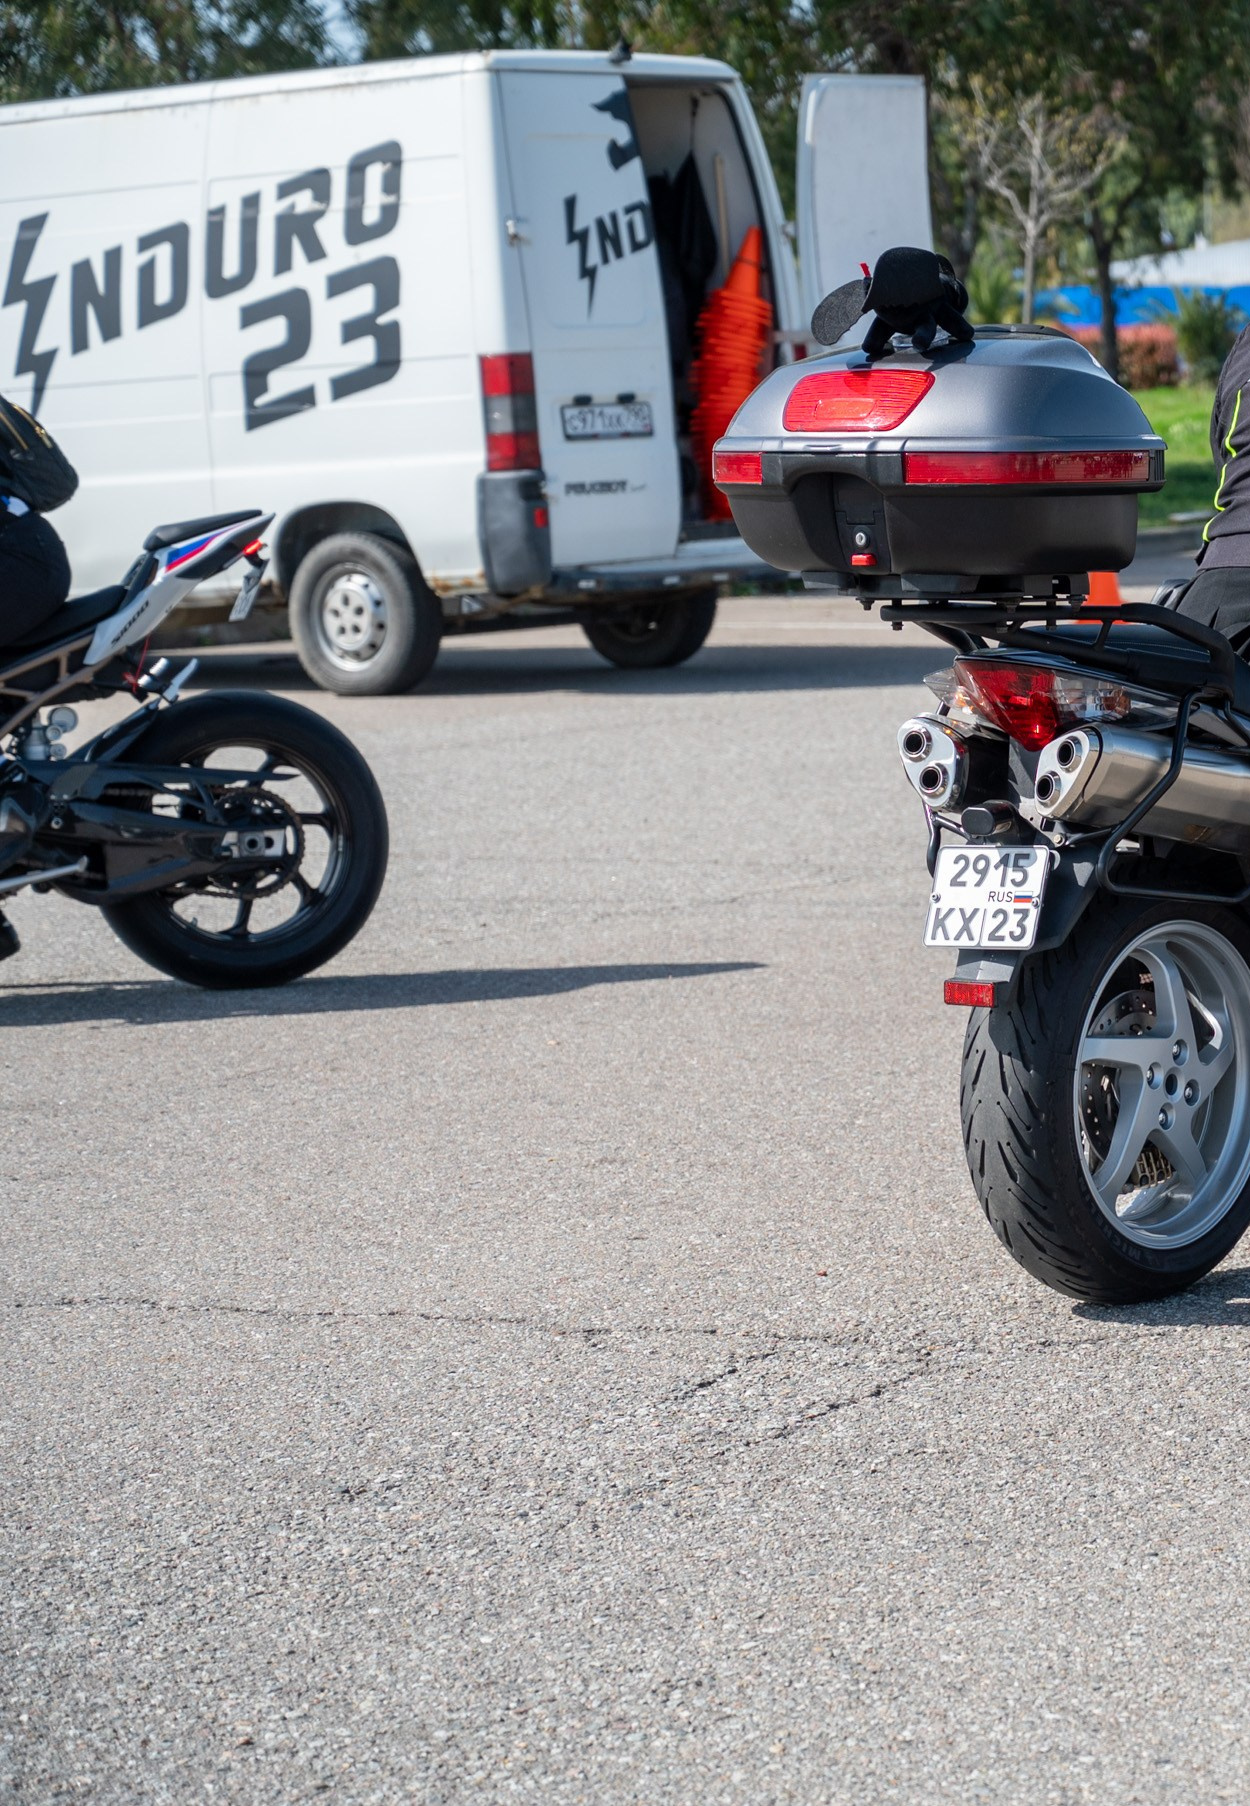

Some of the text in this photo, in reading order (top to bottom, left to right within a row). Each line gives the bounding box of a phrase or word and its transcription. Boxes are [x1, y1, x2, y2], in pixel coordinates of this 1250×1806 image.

[239, 255, 402, 432] 23
[949, 852, 1031, 888] 2915
[987, 890, 1014, 903] RUS
[930, 907, 1031, 942] KX 23
